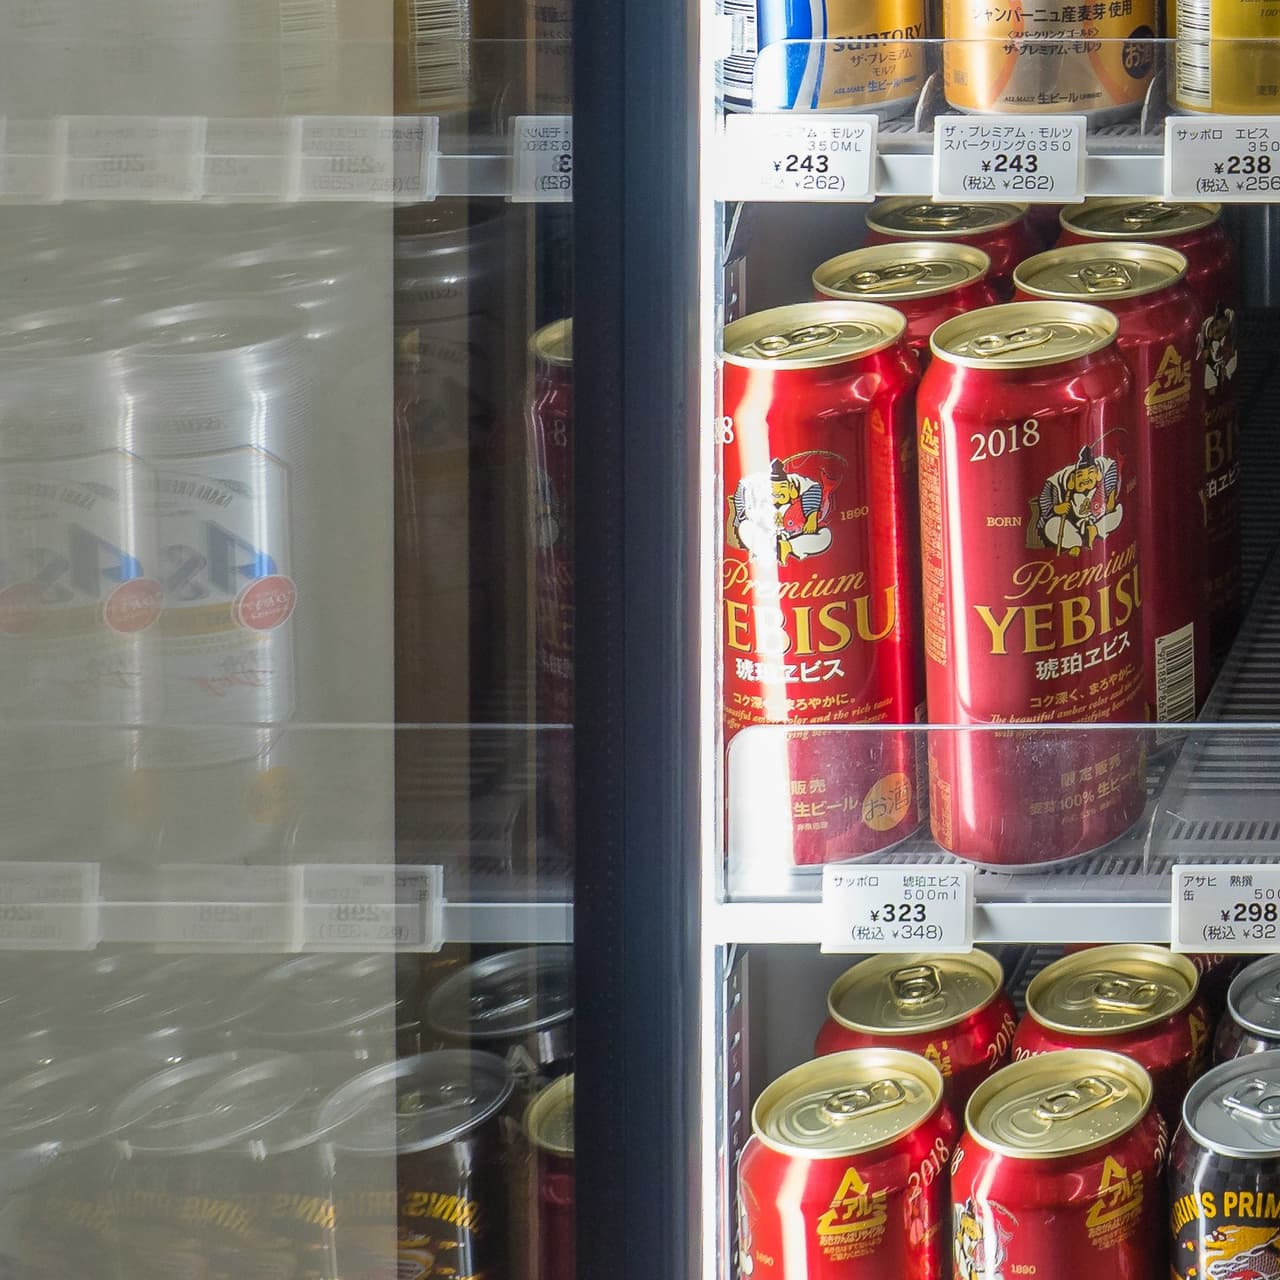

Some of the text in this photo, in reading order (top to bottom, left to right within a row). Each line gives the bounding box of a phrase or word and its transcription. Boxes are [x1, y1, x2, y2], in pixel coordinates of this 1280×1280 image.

[774, 155, 828, 173] ¥243
[982, 154, 1037, 173] ¥243
[1215, 156, 1271, 174] ¥238
[971, 420, 1040, 461] 2018
[987, 517, 1021, 527] BORN
[871, 904, 926, 922] ¥323
[1221, 903, 1277, 922] ¥298
[893, 925, 942, 941] ¥348)
